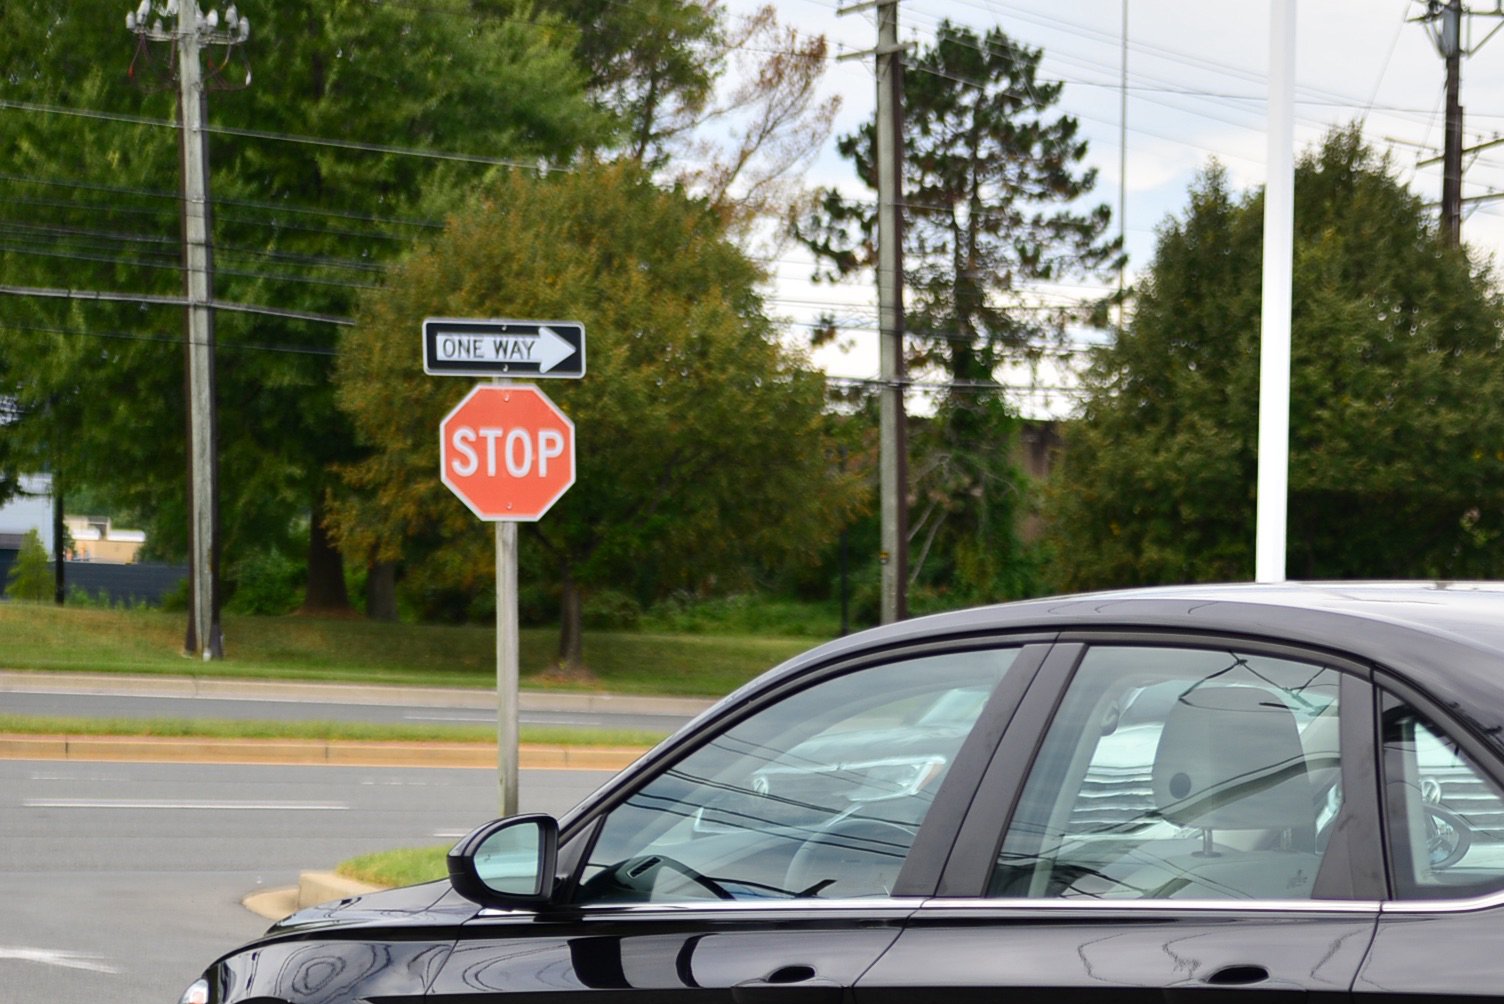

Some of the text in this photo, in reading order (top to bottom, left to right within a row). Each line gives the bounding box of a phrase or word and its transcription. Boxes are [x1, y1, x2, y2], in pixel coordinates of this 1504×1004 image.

[442, 338, 536, 361] ONE WAY
[451, 427, 566, 478] STOP
